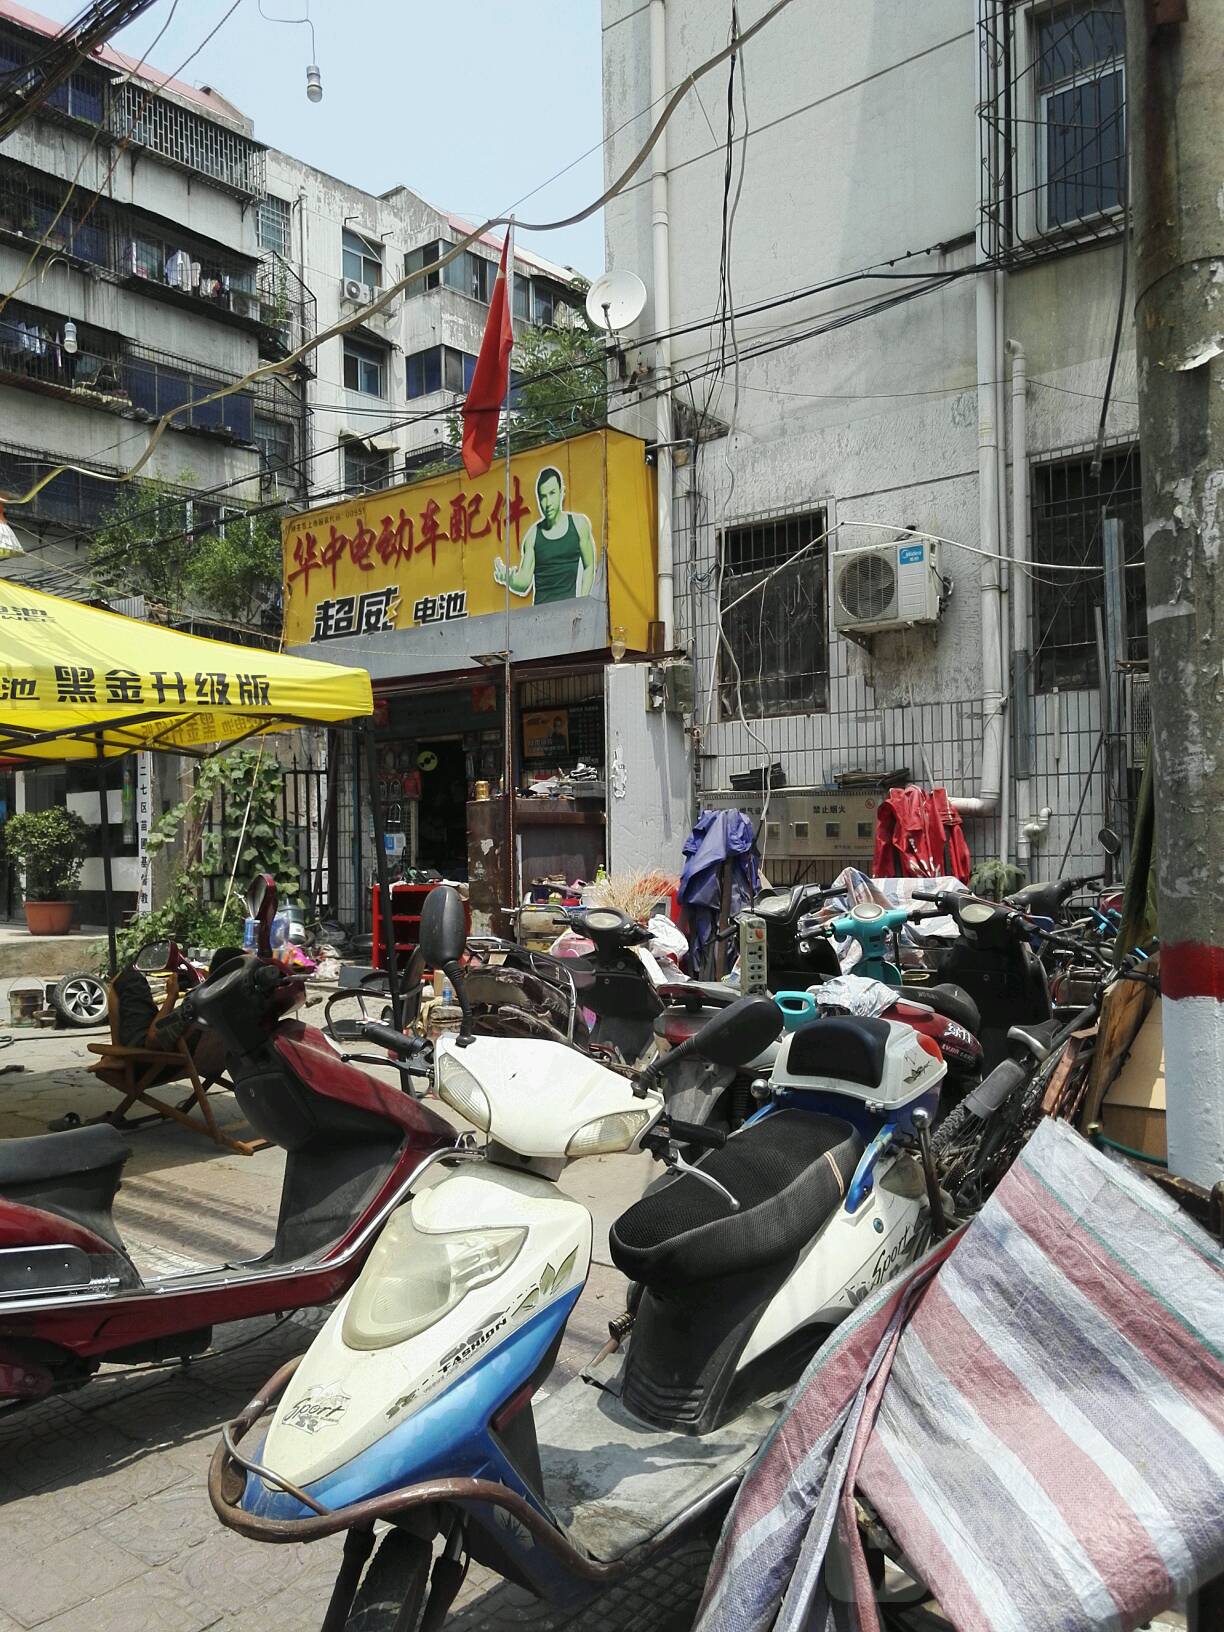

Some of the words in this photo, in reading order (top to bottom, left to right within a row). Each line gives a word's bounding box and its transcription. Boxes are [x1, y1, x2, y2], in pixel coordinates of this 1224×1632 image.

[287, 475, 531, 594] 华中电动车配件
[311, 586, 401, 643] 超威
[413, 590, 469, 626] 电池
[55, 665, 272, 706] 黑金升级版
[812, 804, 846, 814] 禁止烟火
[437, 1317, 508, 1374] FASHION
[282, 1397, 345, 1422] Sport
